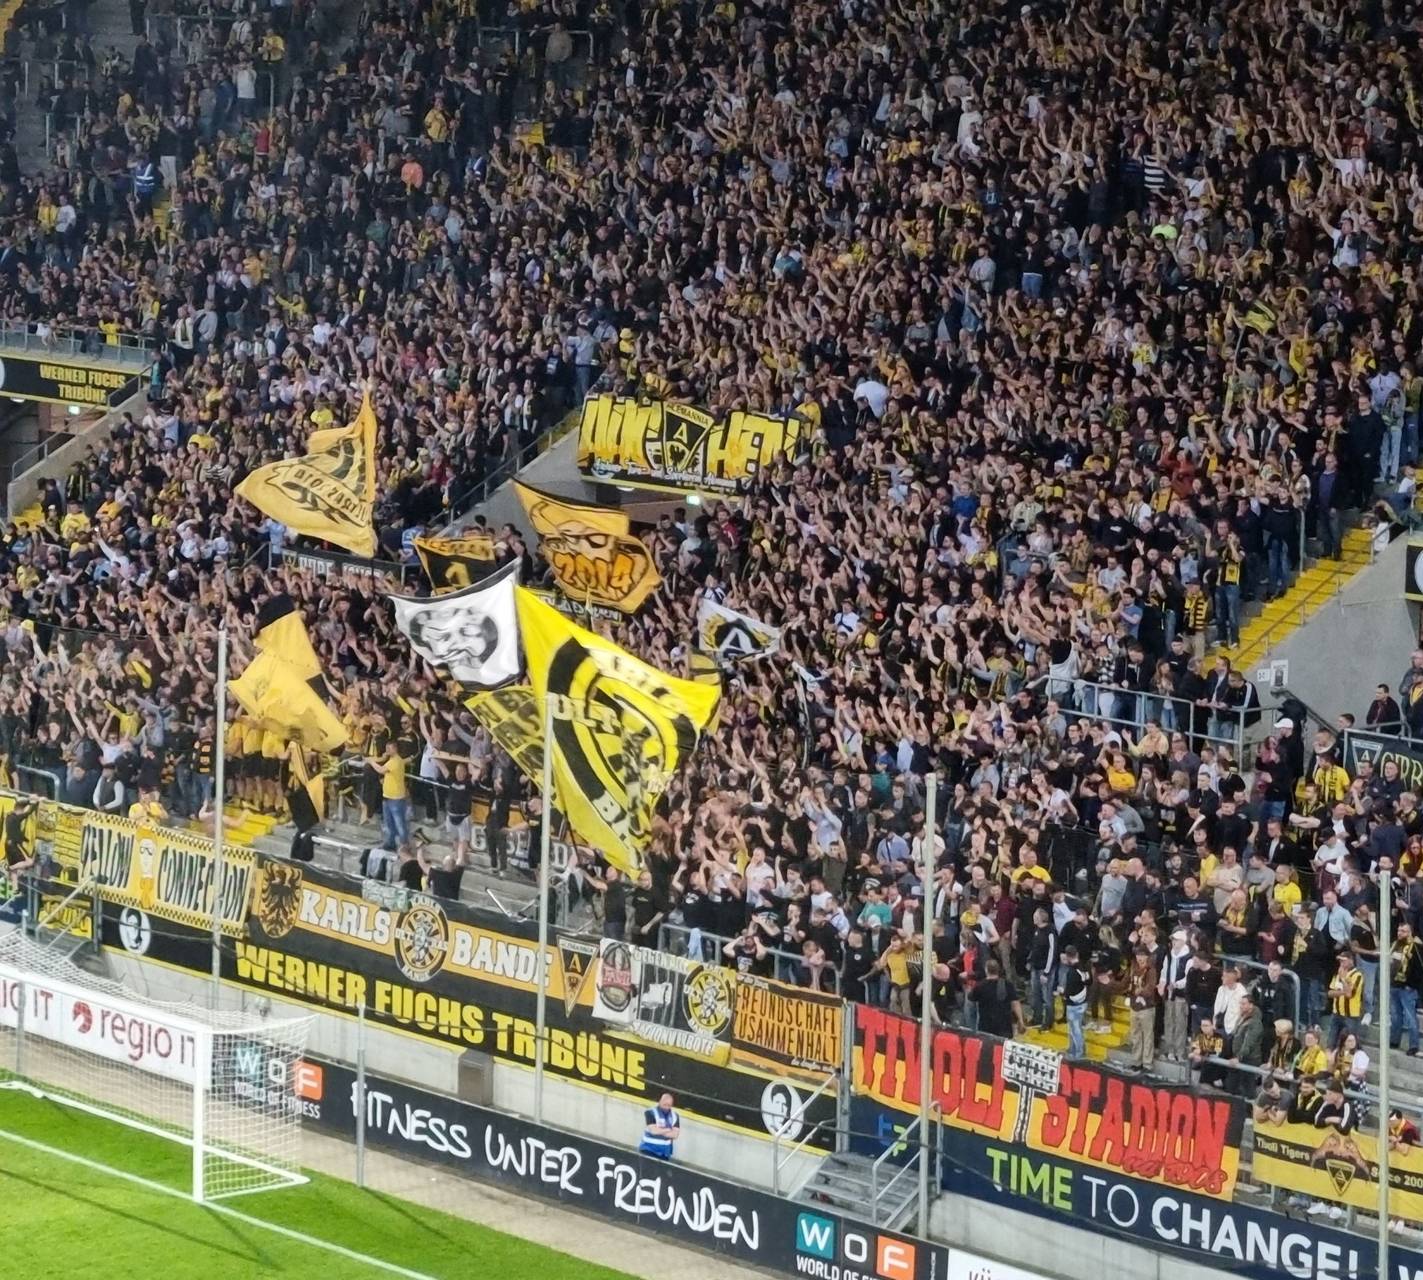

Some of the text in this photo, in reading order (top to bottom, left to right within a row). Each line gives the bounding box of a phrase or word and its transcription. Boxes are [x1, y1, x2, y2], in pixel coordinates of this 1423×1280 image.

[40, 363, 126, 389] WERNER FUCHS
[553, 552, 634, 596] 2014
[300, 889, 392, 945] KARLS
[100, 1006, 172, 1061] regio
[235, 941, 647, 1090] WERNER FUCHS TRIBÜNE
[736, 981, 837, 1035] FREUNDSCHAFT
[855, 1004, 1231, 1170] TIVOLI STADION
[351, 1080, 760, 1251] FITNESS UNTER FREUNDEN
[1281, 1144, 1310, 1161] Tigers
[985, 1147, 1359, 1280] TIME TO CHANGE!
[796, 1254, 841, 1280] WORLD
